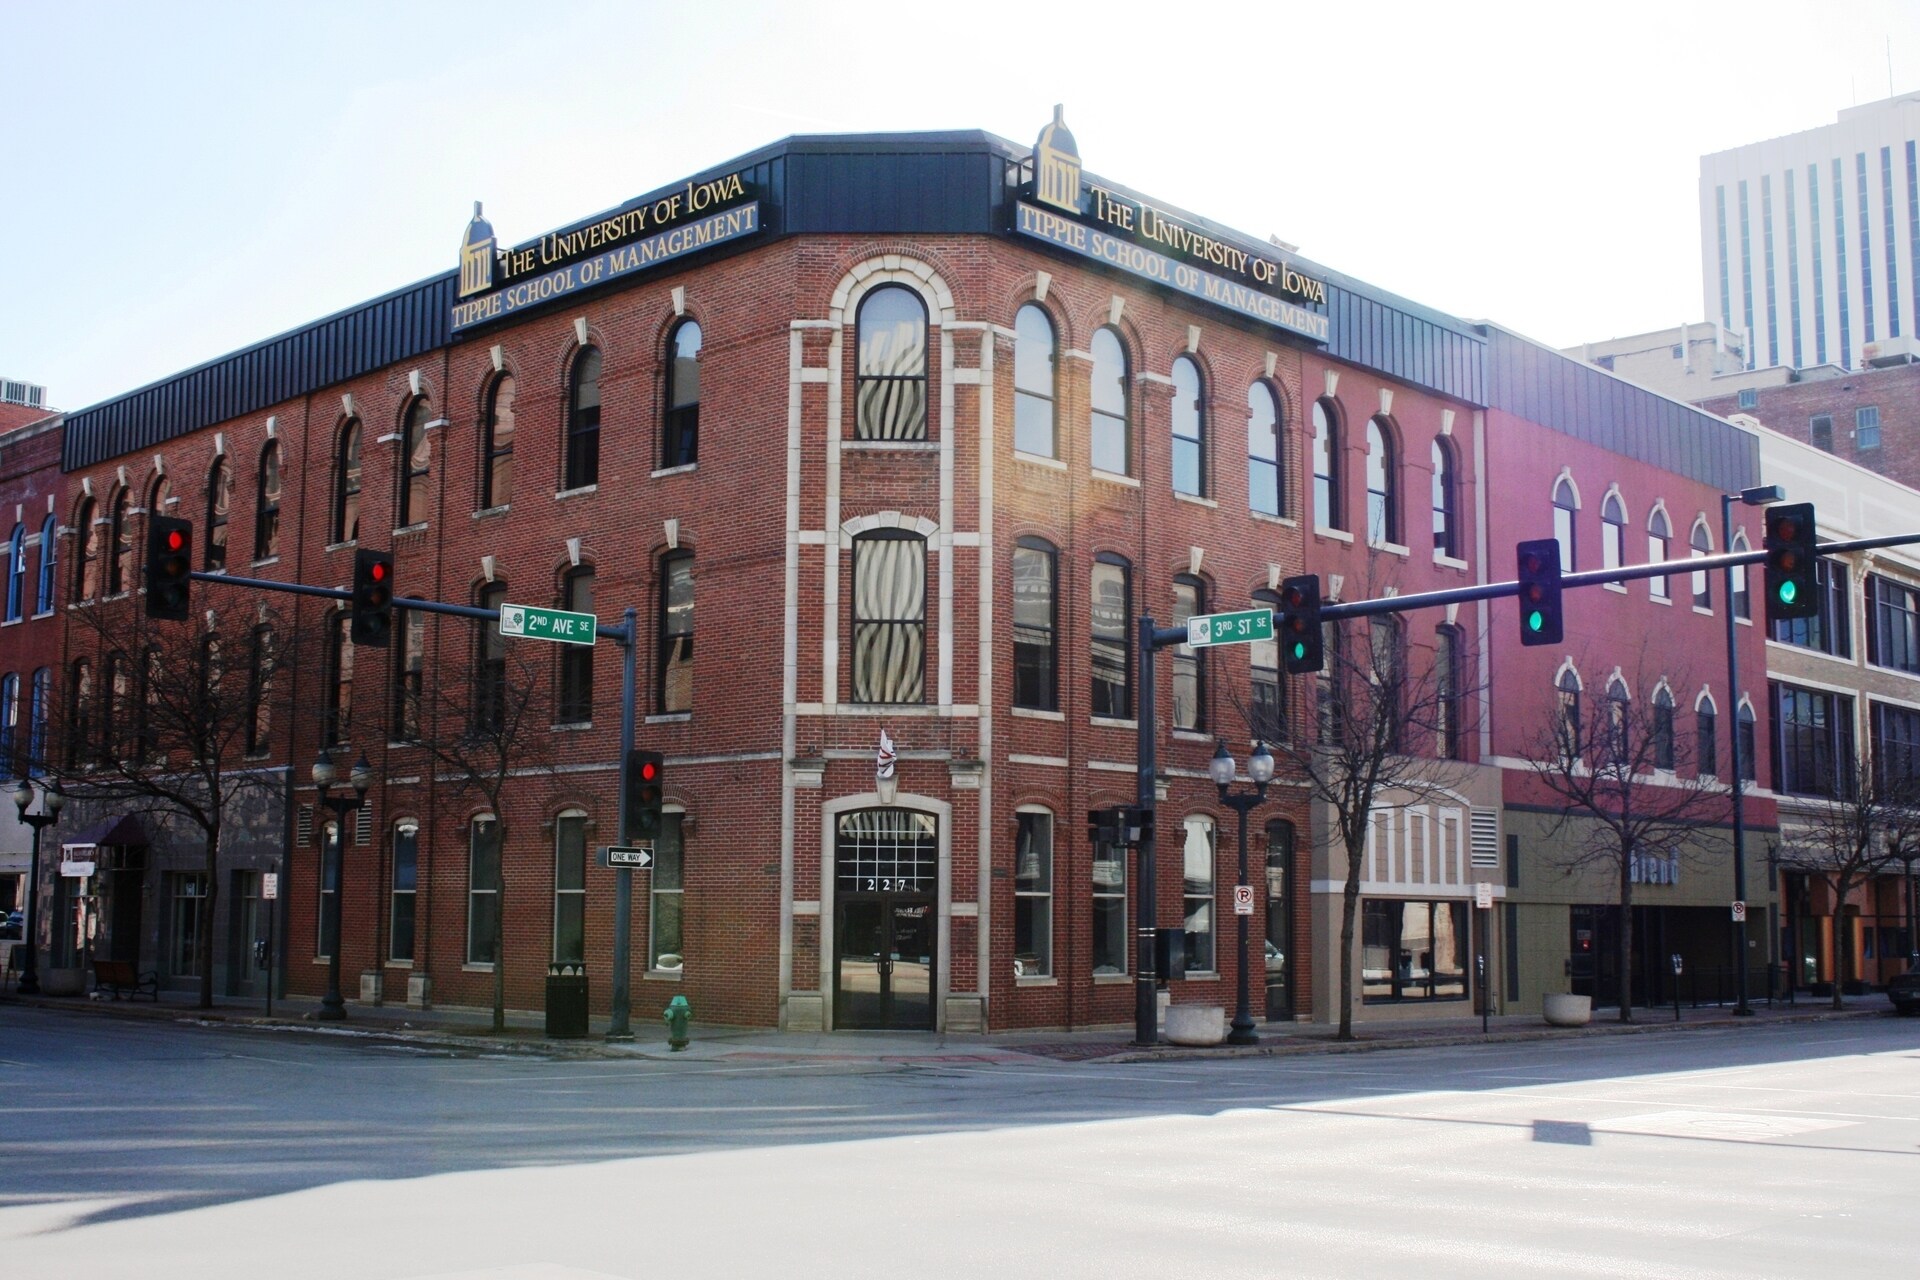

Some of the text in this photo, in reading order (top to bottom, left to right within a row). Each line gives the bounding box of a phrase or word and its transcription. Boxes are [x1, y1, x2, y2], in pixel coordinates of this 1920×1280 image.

[452, 205, 757, 328] TIPPIE SCHOOL OF MANAGEMENT
[500, 173, 744, 279] THE UNIVERSITY OF IOWA
[1019, 204, 1328, 338] TIPPIE SCHOOL OF MANAGEMENT
[1091, 185, 1327, 304] THE UNIVERSITY OF IOWA
[528, 614, 548, 631] 2ND
[552, 618, 574, 635] AVE
[579, 621, 590, 632] SE
[1215, 620, 1233, 637] 3RD
[1238, 618, 1252, 636] ST
[1256, 617, 1267, 628] SE
[612, 852, 641, 861] ONE WAY
